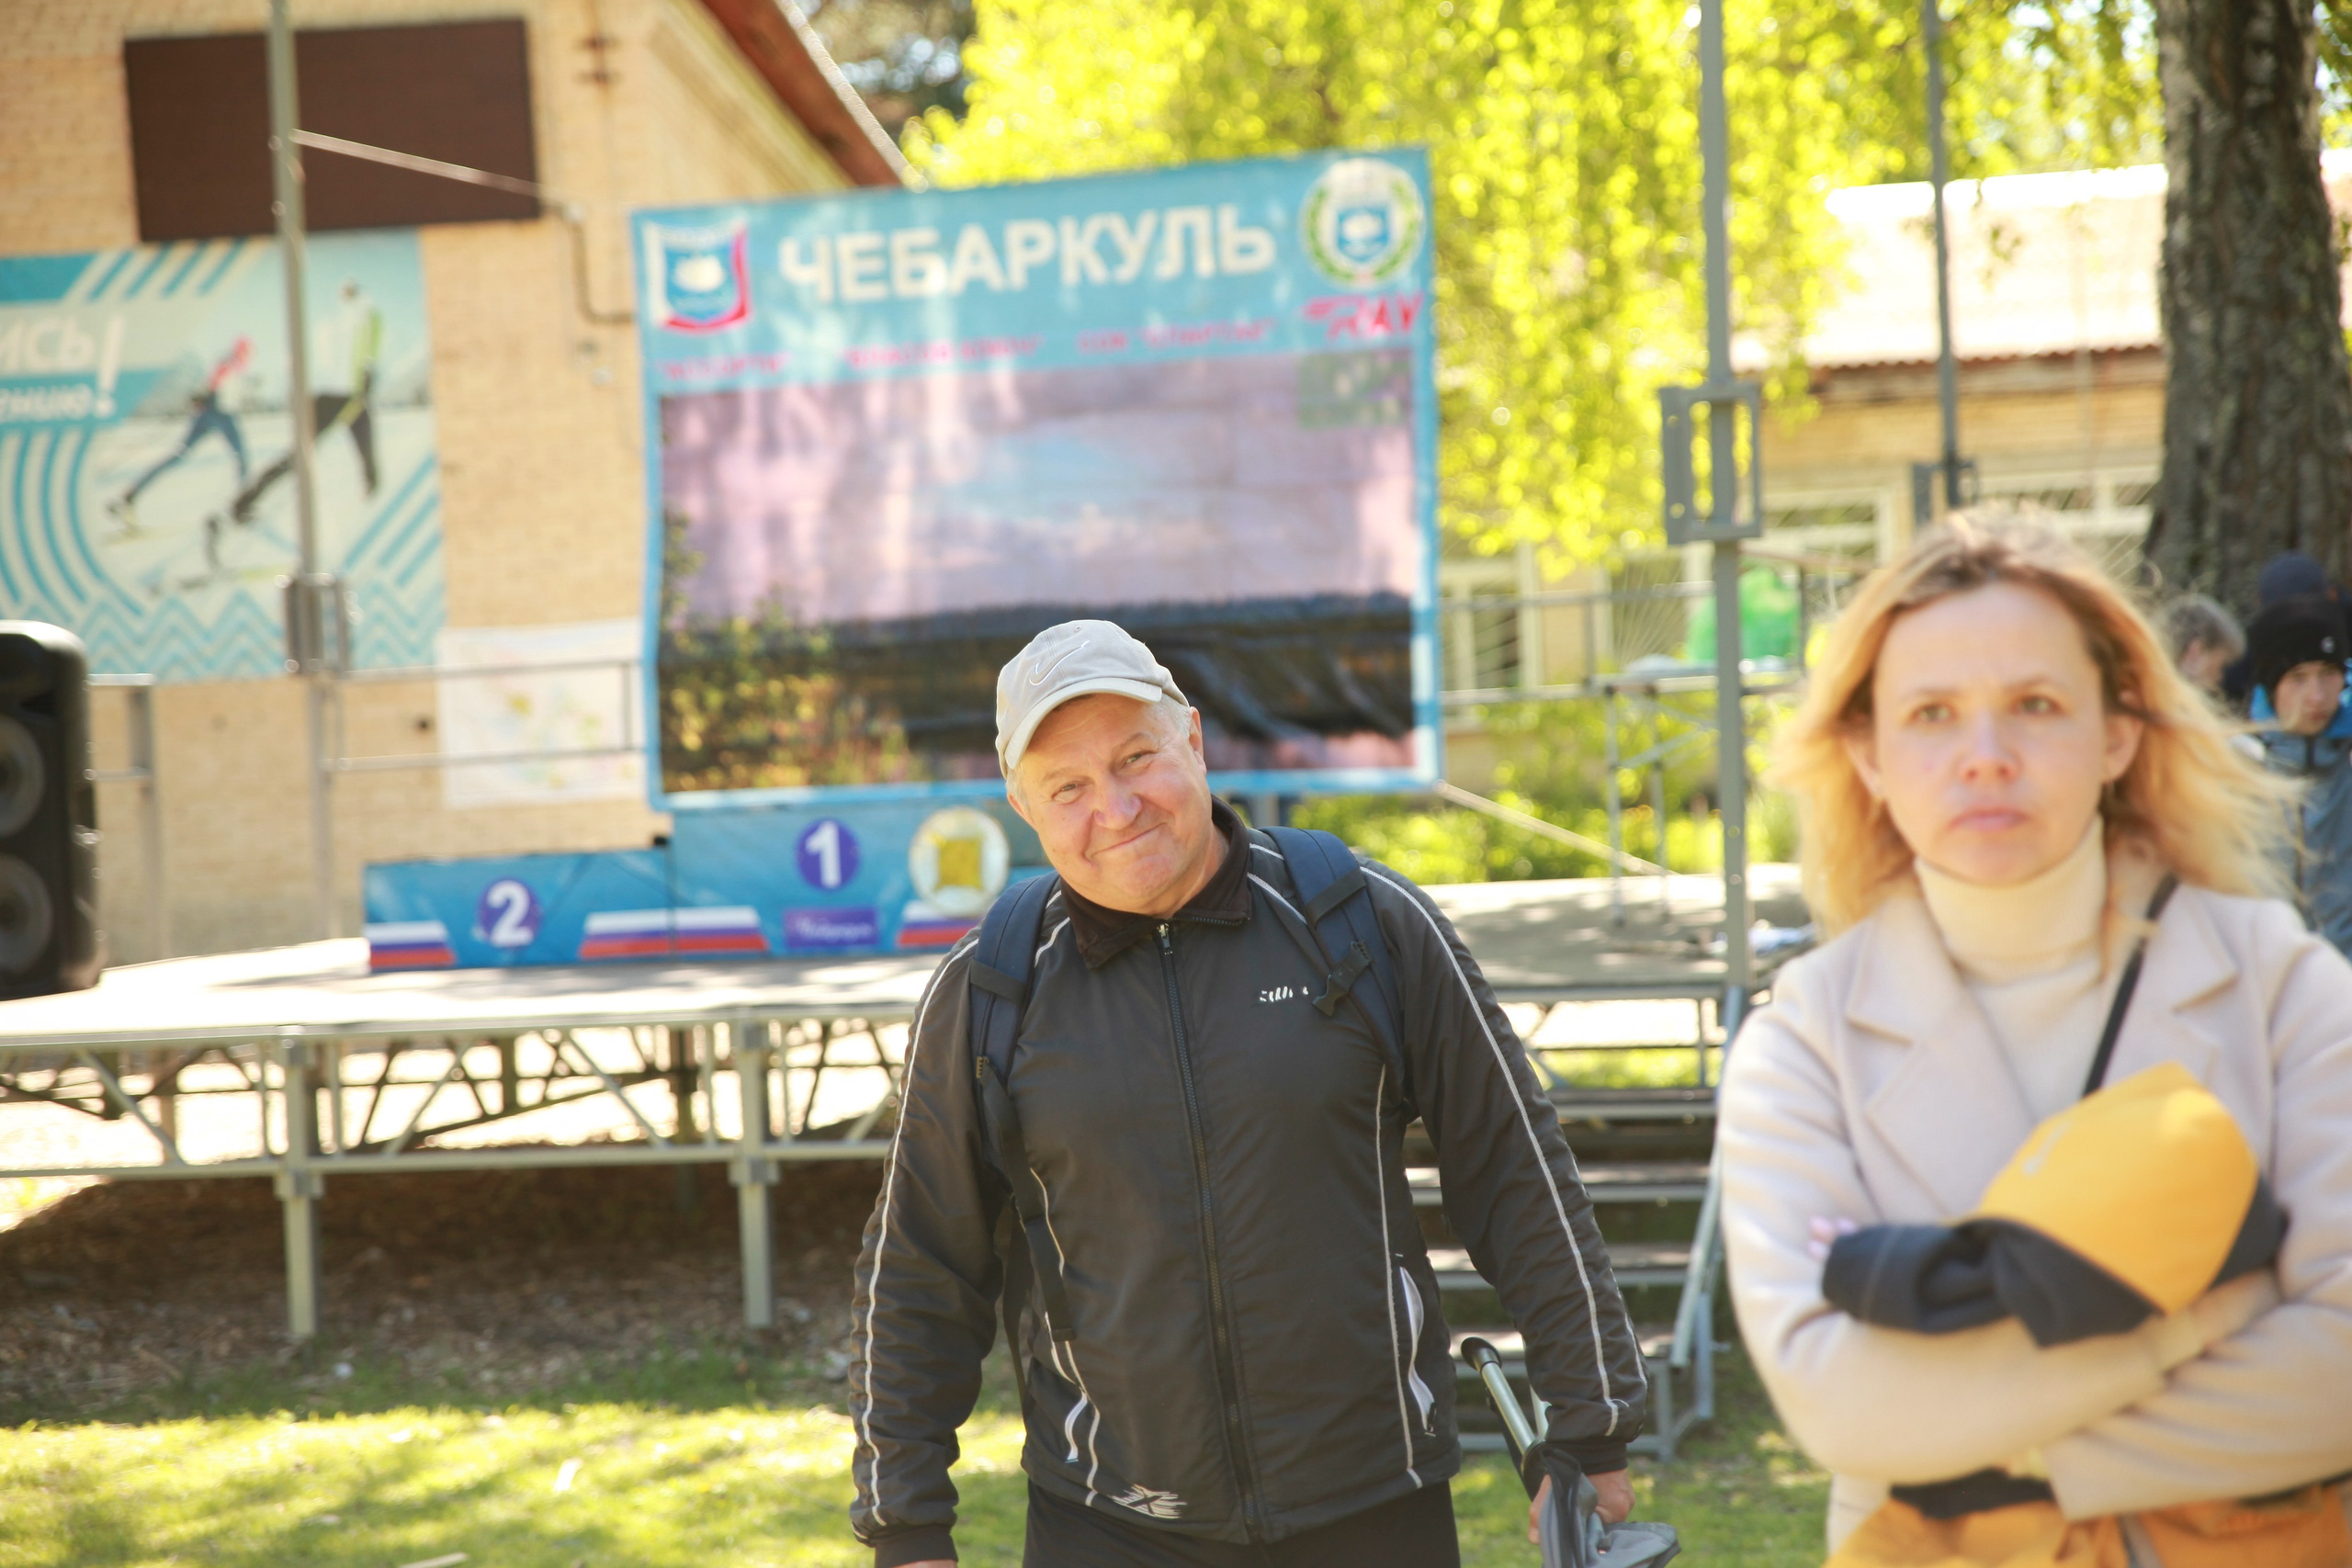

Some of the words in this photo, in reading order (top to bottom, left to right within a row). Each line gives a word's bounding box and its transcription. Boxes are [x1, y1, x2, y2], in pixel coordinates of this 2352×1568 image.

[777, 203, 1278, 303] ЧЕБАРКУЛЬ
[806, 820, 842, 888] 1
[488, 880, 534, 947] 2
